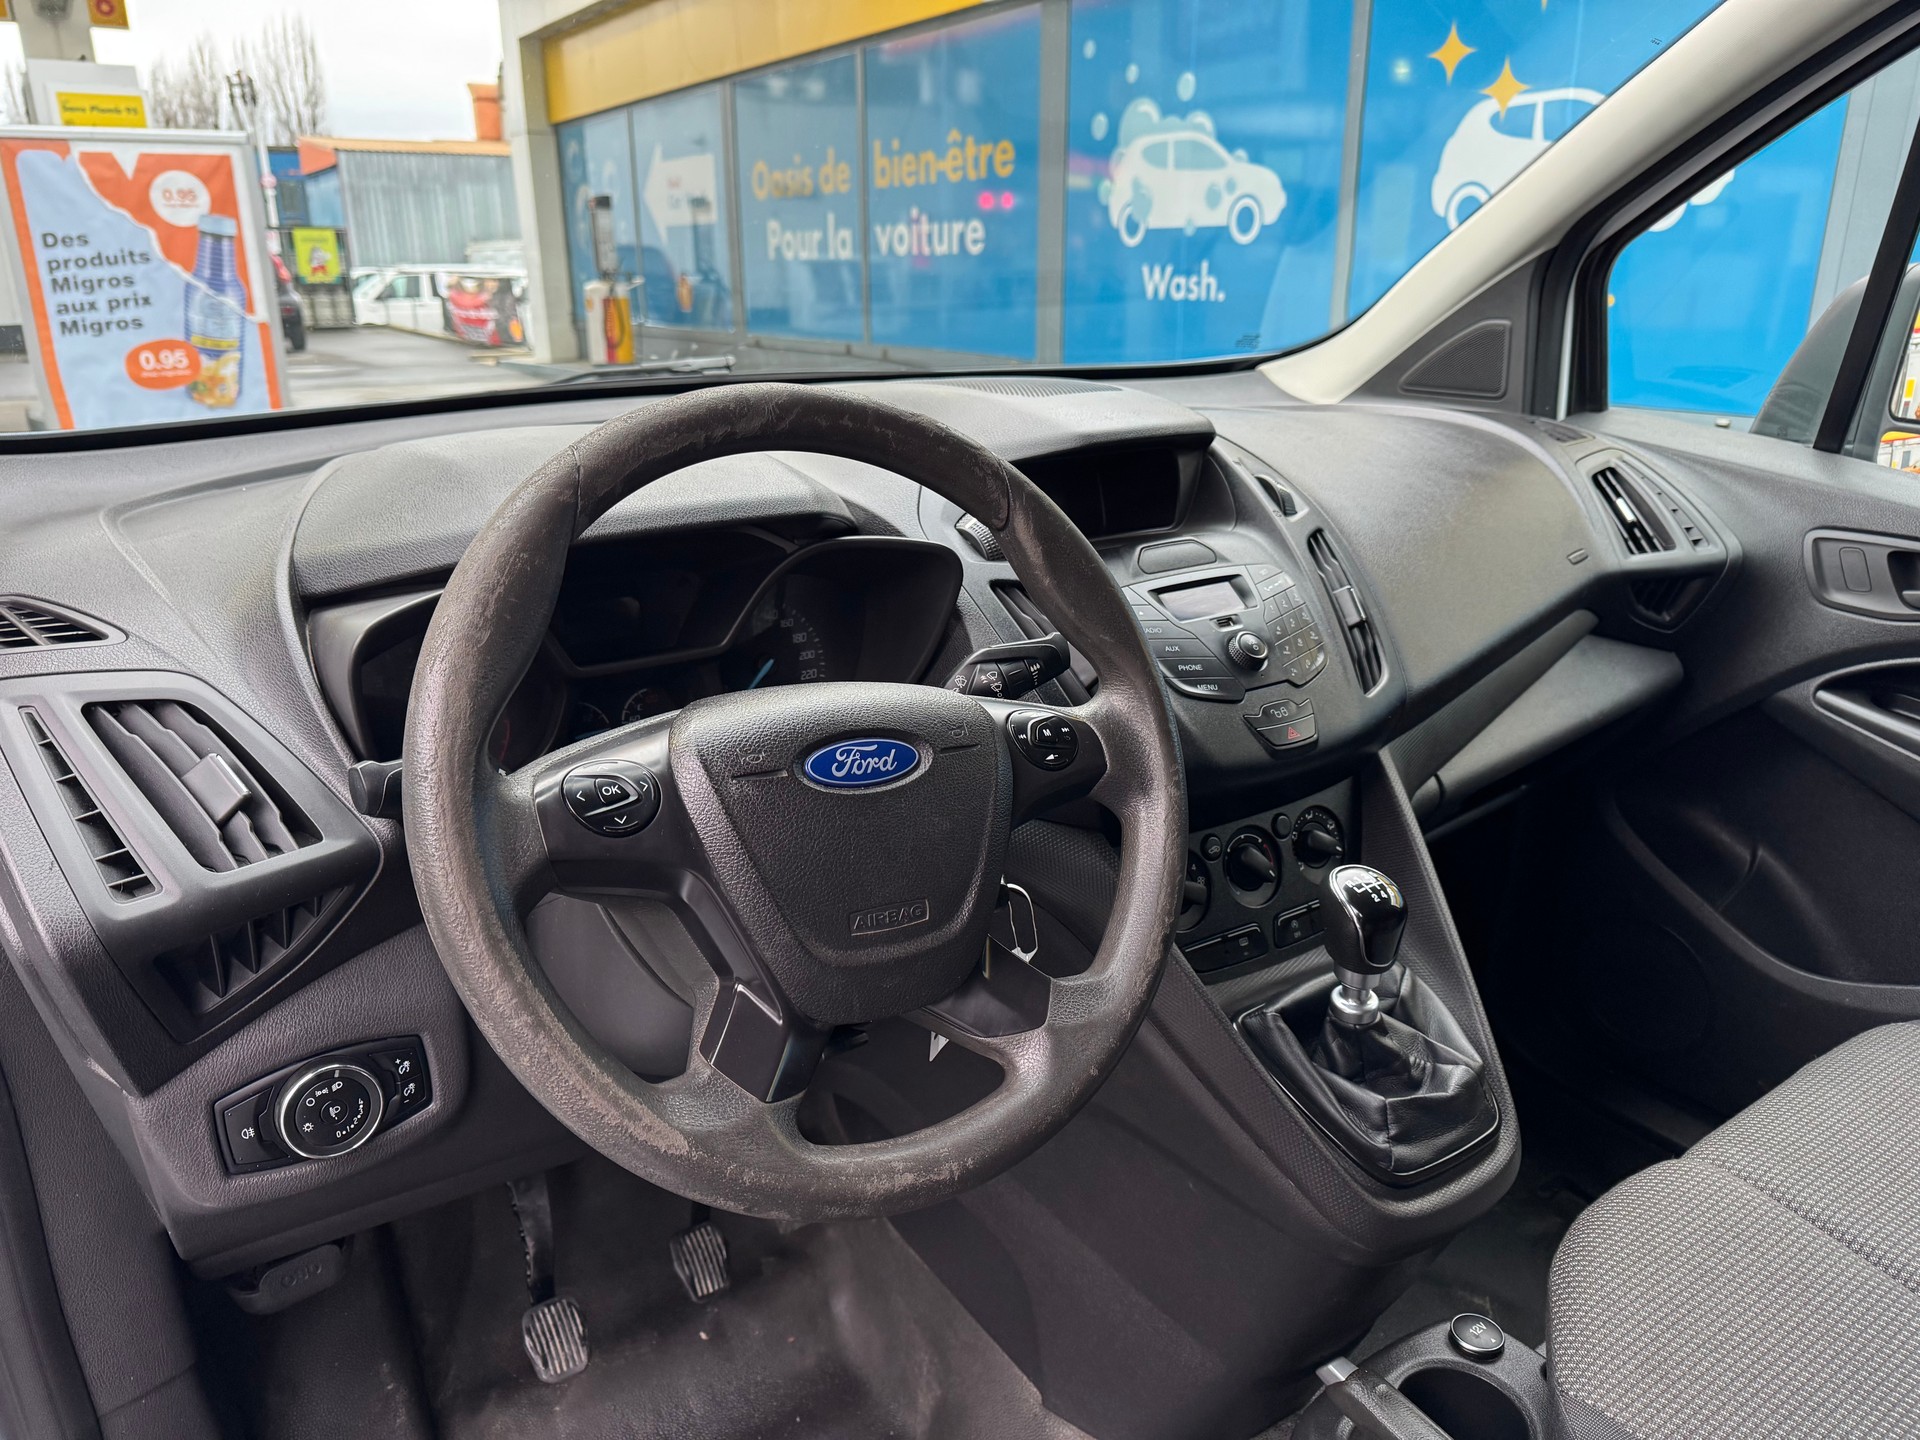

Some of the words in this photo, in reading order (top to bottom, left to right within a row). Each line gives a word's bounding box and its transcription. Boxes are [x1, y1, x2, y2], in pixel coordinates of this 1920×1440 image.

[752, 154, 814, 200] Oasis
[819, 146, 852, 194] de
[873, 128, 1016, 189] bien-être
[162, 188, 198, 203] 0.95
[41, 232, 90, 248] Des
[766, 219, 822, 260] Pour
[827, 211, 853, 259] la
[874, 205, 986, 256] voiture
[47, 249, 151, 274] produits
[51, 275, 136, 294] Migros
[1141, 259, 1226, 302] Wash.
[56, 301, 98, 315] aux
[107, 292, 152, 313] prix
[59, 317, 144, 338] Migros
[138, 348, 190, 371] 0.95
[799, 650, 816, 661] 200
[801, 668, 818, 680] 220
[1178, 663, 1204, 671] PHONE
[1042, 728, 1052, 737] M
[831, 743, 899, 778] Ford
[602, 784, 621, 796] OK
[1371, 893, 1381, 903] 2
[1380, 890, 1388, 899] 4
[853, 904, 924, 930] AIRBAG
[335, 1130, 342, 1138] 0
[353, 1117, 359, 1125] 2
[1469, 1321, 1487, 1336] 12V
